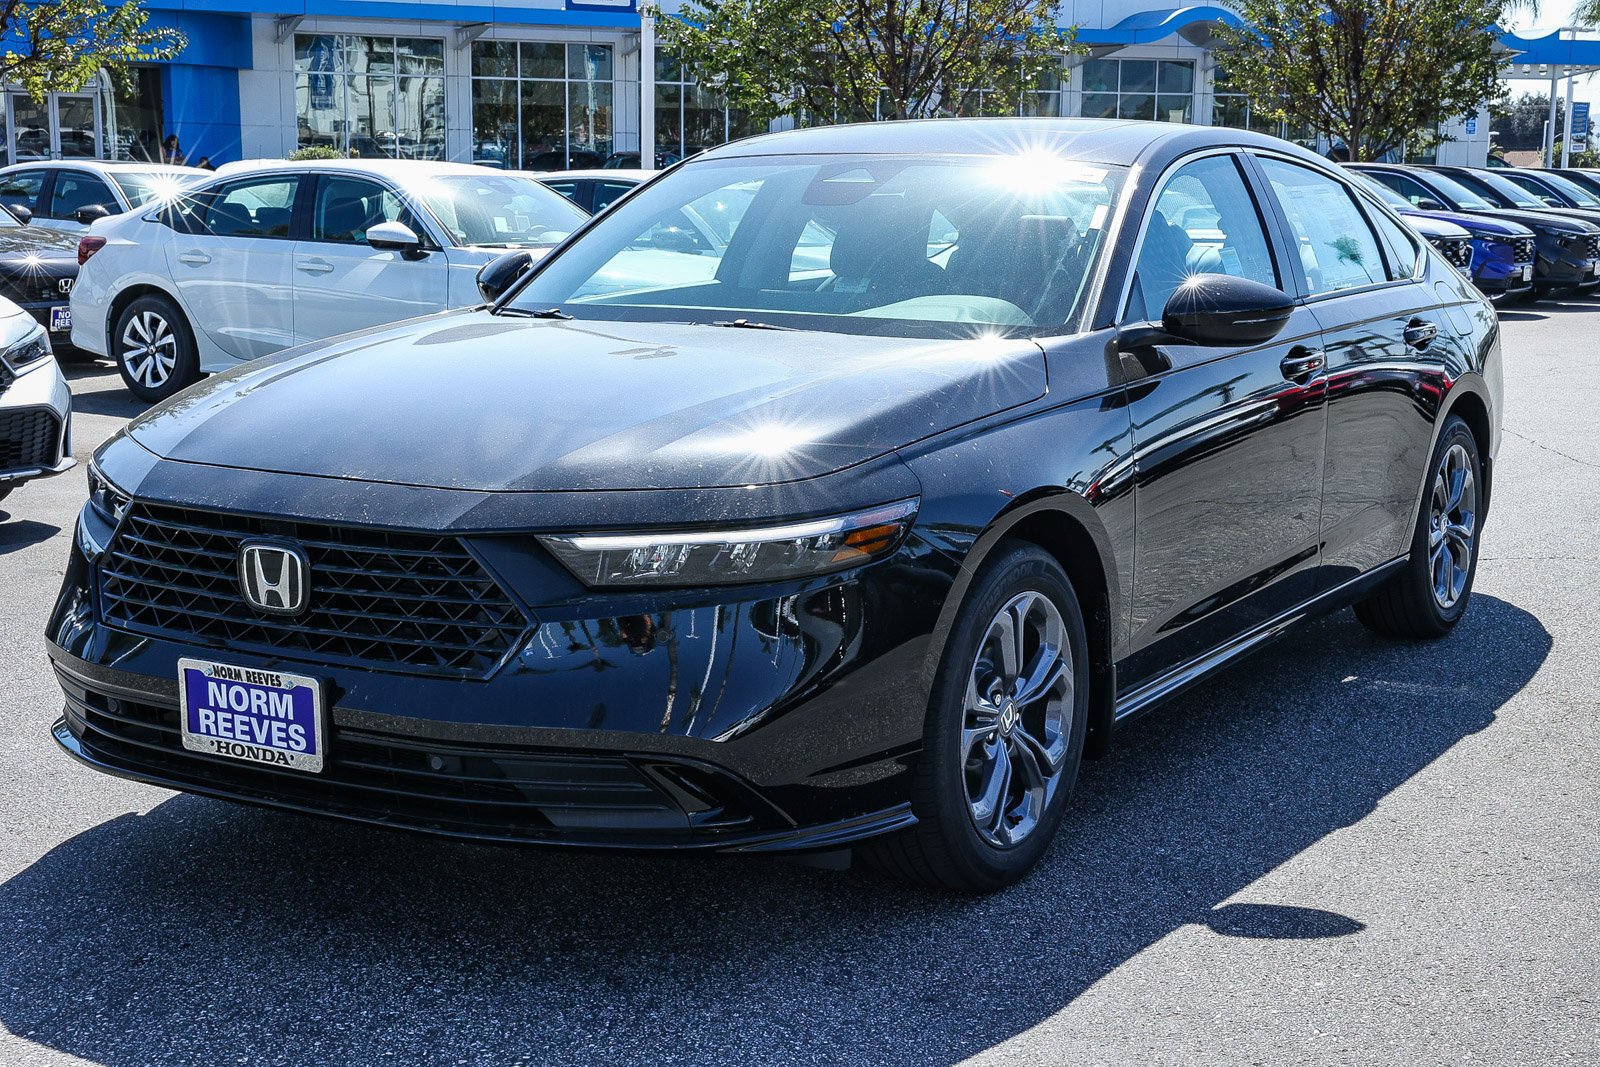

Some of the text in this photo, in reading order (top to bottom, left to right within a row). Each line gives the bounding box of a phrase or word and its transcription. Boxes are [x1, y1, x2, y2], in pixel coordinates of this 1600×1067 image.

[55, 319, 73, 327] REE
[58, 311, 71, 319] NO
[212, 665, 282, 687] NORM REEVES
[207, 681, 294, 721] NORM
[198, 708, 307, 751] REEVES
[214, 740, 291, 766] HONDA
